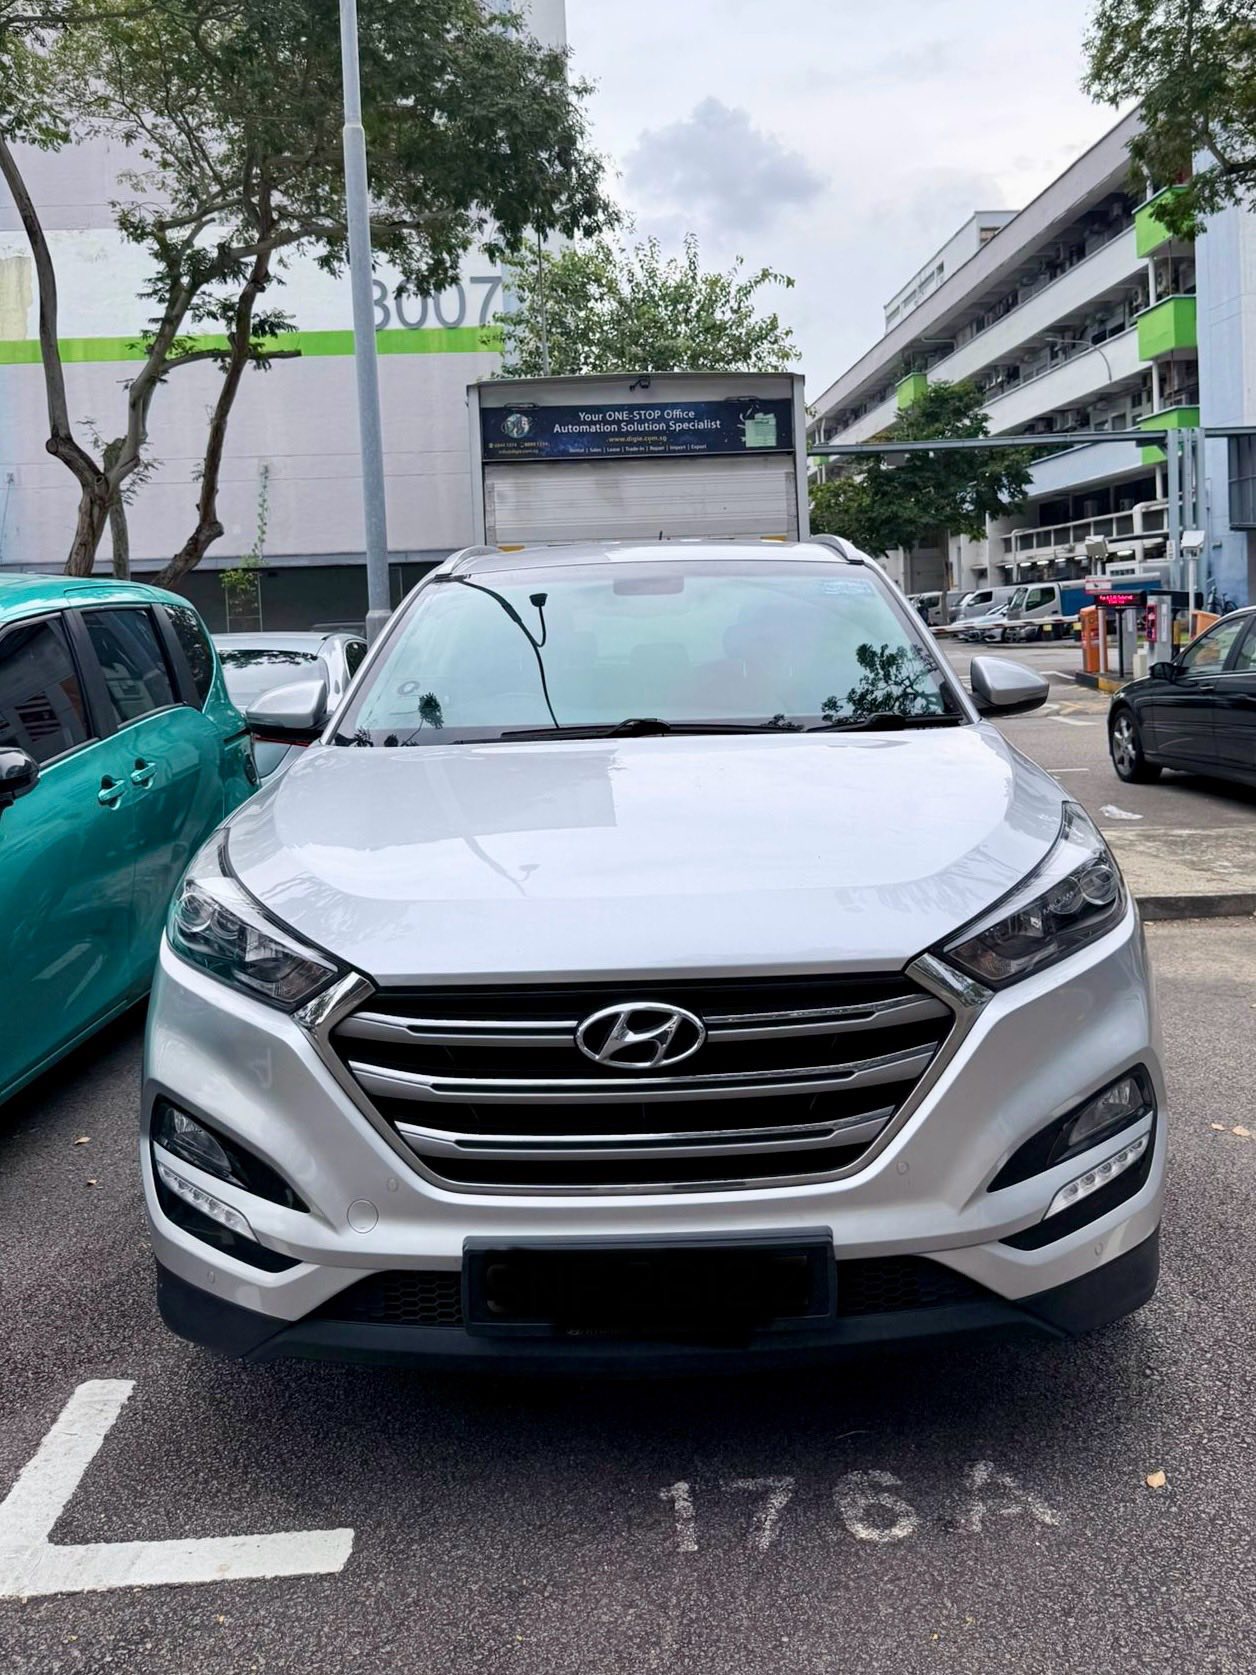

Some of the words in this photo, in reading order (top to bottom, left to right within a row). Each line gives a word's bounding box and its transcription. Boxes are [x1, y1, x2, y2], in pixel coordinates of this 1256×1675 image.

[578, 412, 603, 421] Your
[606, 410, 661, 421] ONE-STOP
[664, 409, 695, 419] Office
[553, 423, 618, 433] Automation
[621, 421, 667, 432] Solution
[670, 420, 721, 432] Specialist
